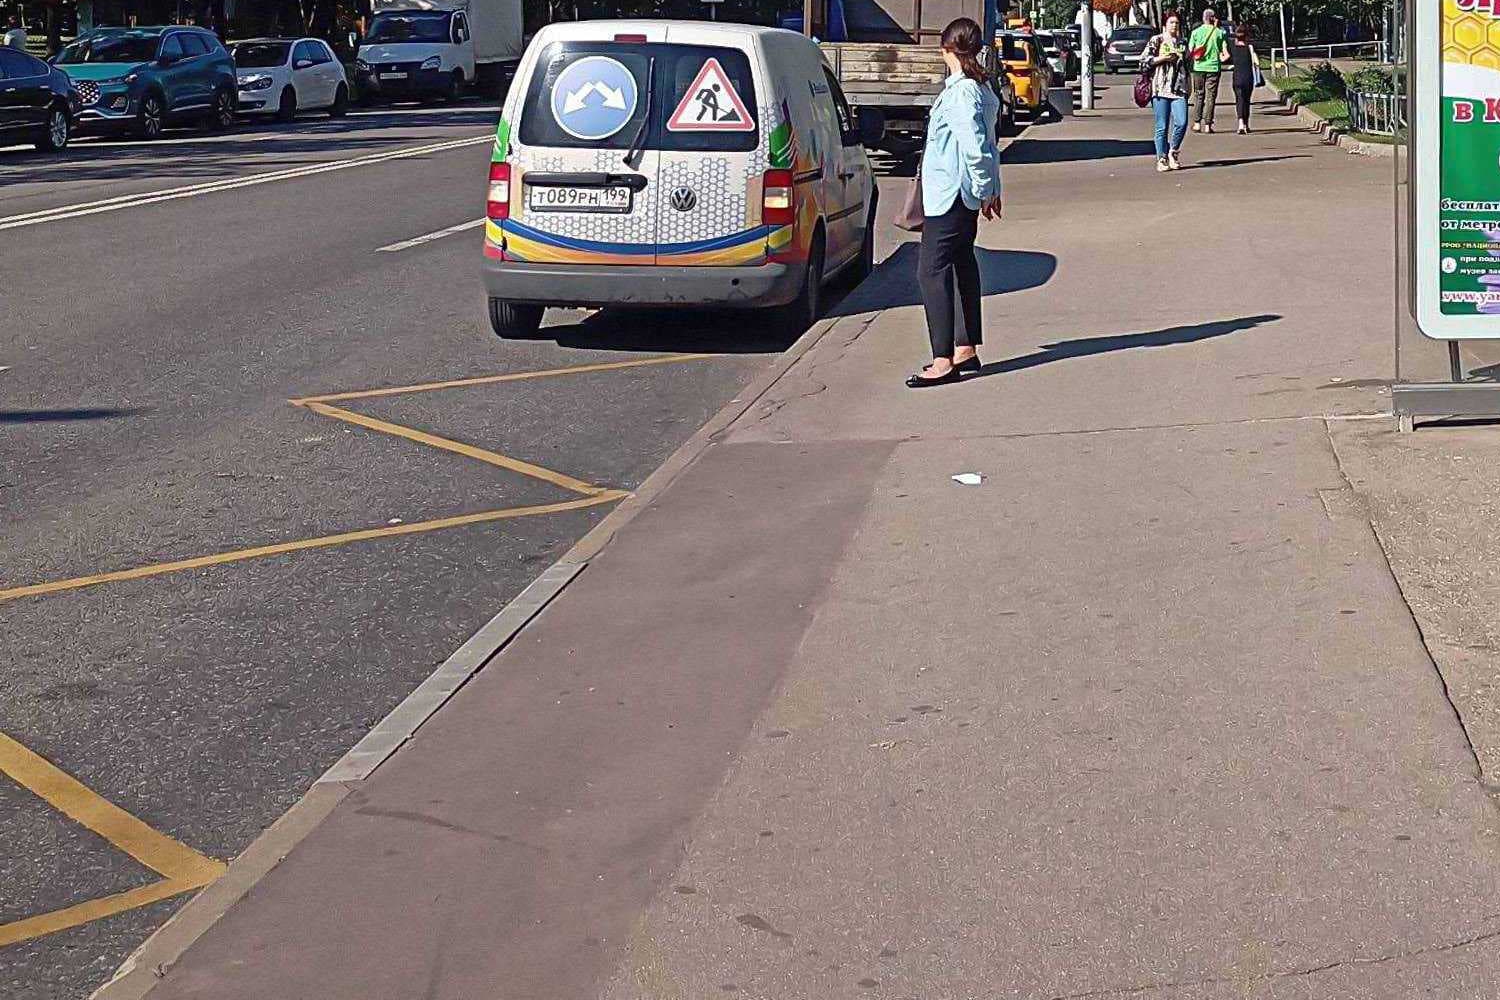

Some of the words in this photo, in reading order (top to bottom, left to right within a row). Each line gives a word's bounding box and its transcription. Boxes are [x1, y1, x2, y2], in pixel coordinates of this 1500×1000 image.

[1455, 103, 1472, 121] в
[602, 189, 627, 202] 199
[1441, 220, 1457, 229] от
